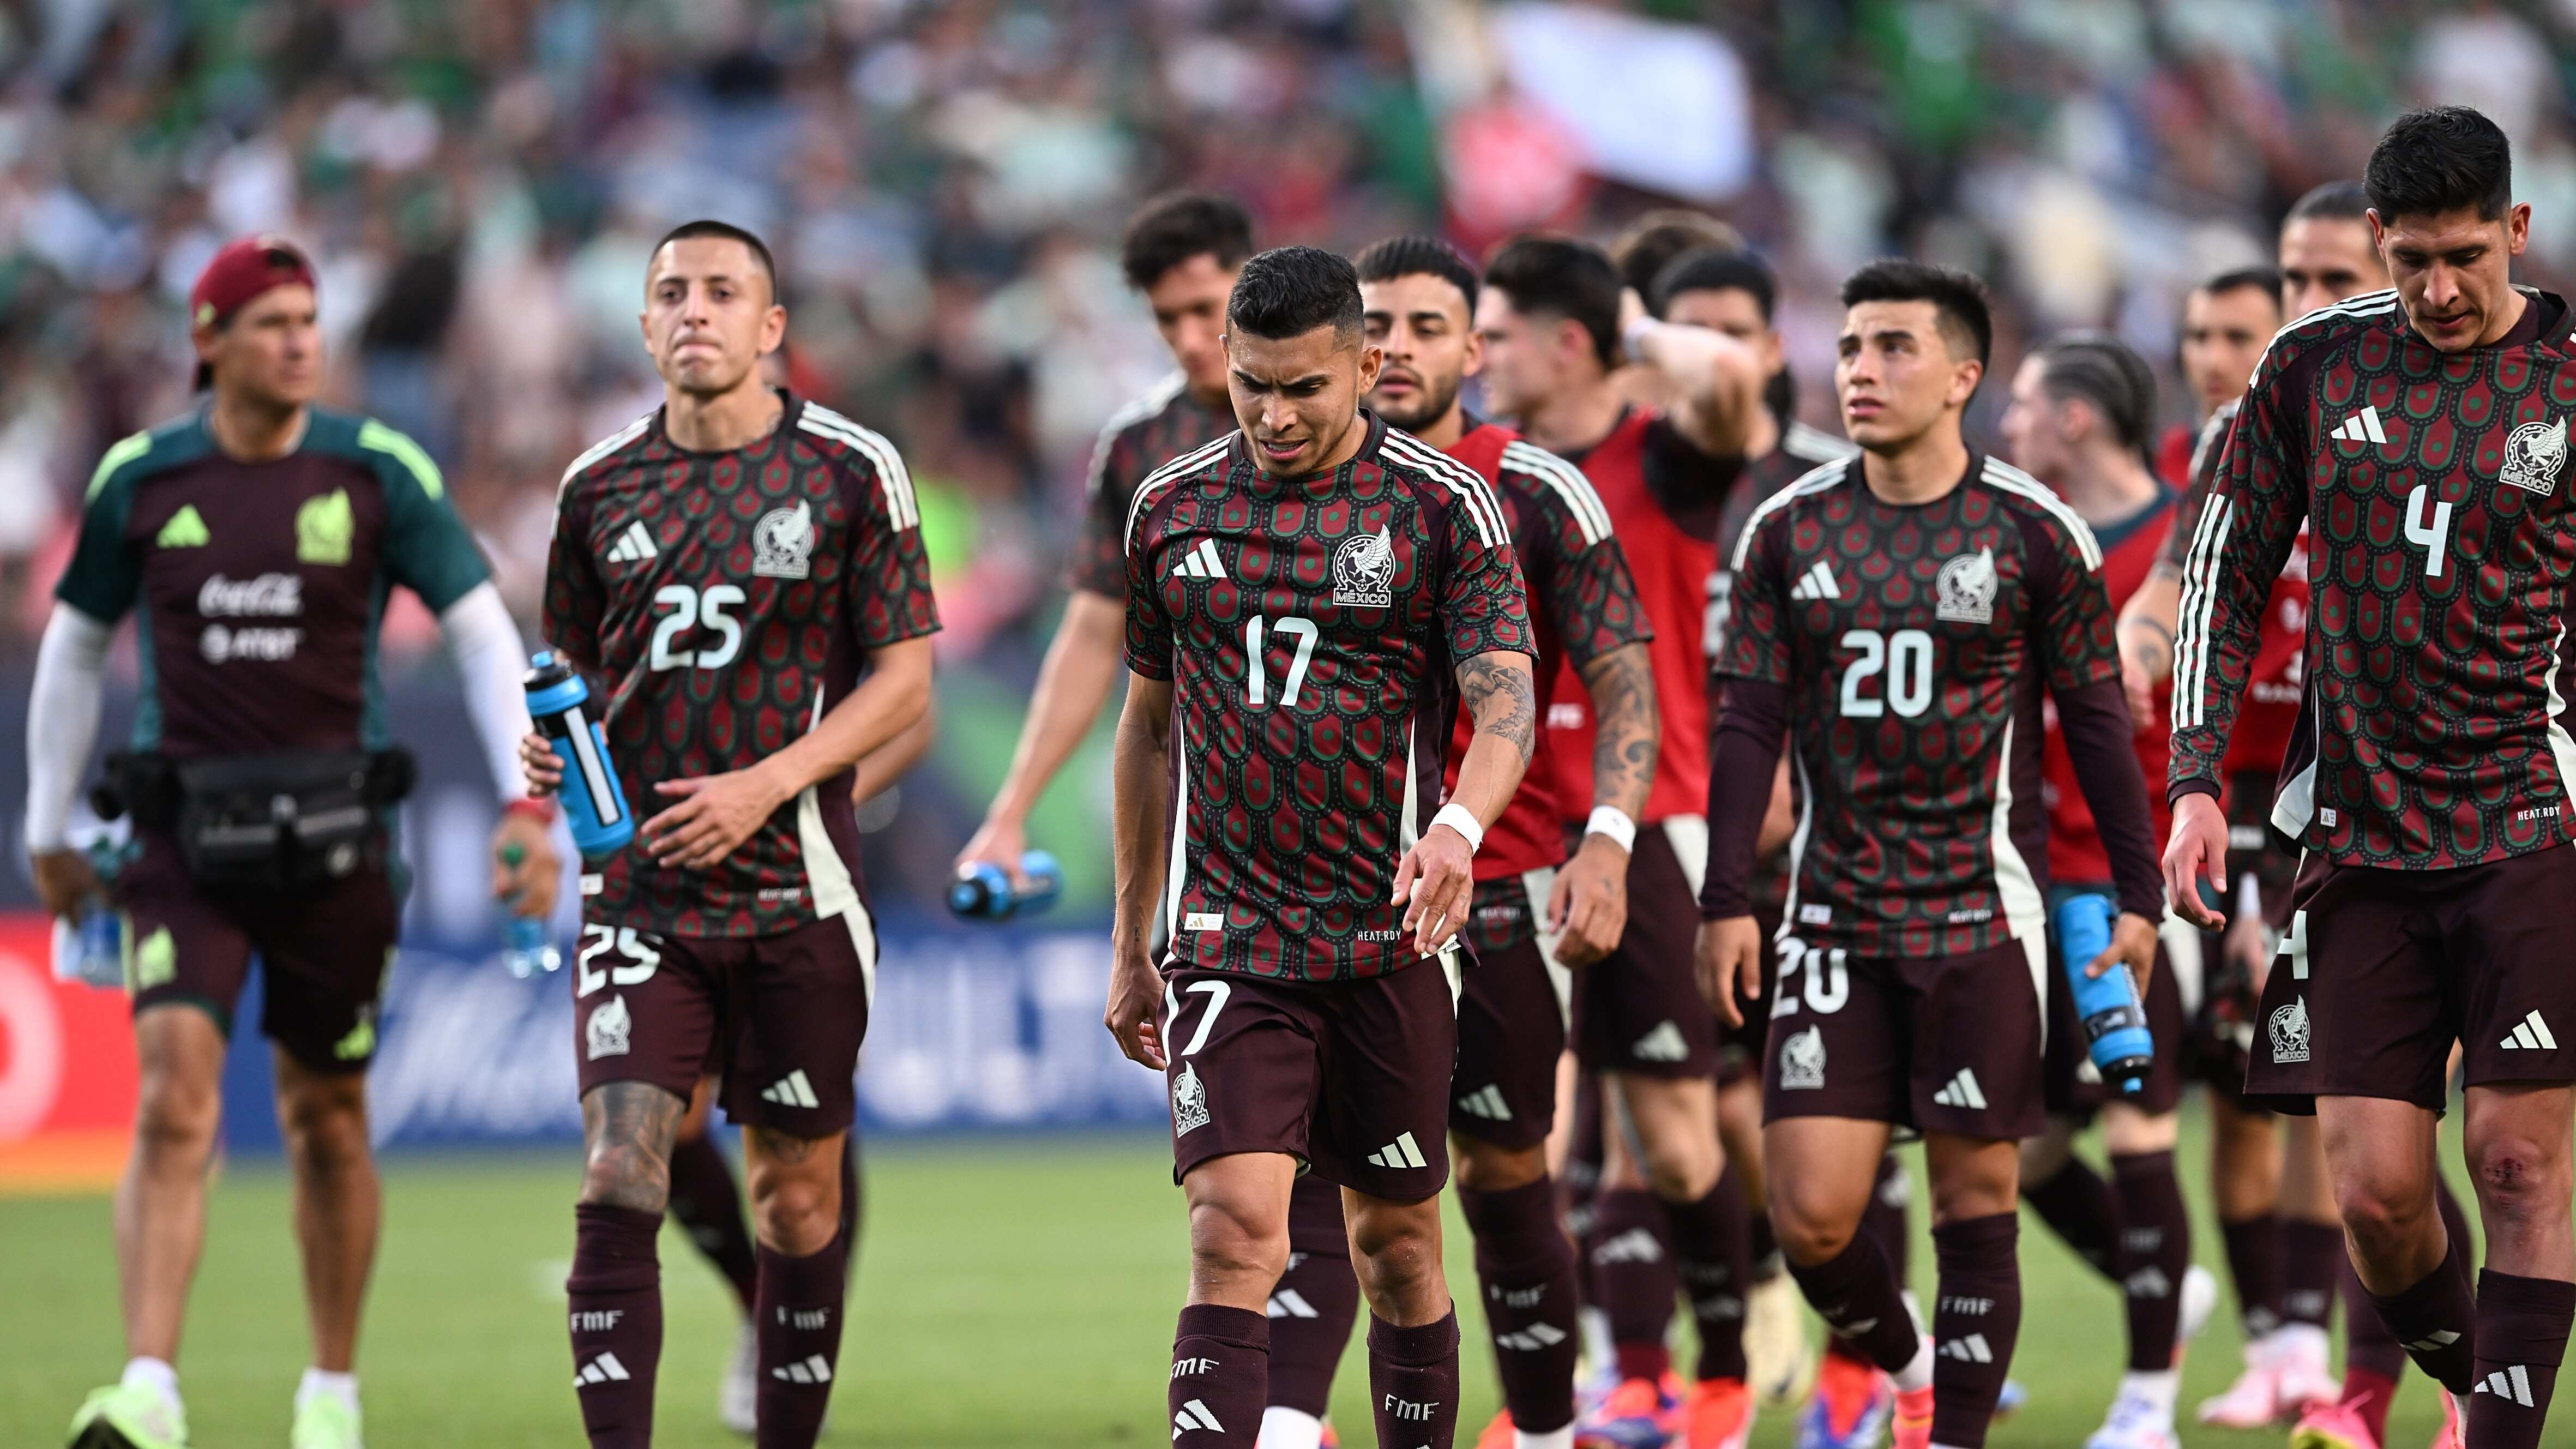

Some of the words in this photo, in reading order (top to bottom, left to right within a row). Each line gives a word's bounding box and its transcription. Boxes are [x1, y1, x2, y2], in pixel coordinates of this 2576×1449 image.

[2502, 470, 2551, 492] MÉXICO
[2404, 484, 2452, 577] 4
[1335, 589, 1388, 604] MÉXICO
[650, 585, 746, 671] 25
[1245, 614, 1319, 706] 17
[1840, 629, 1933, 718] 20
[2517, 806, 2560, 821] HEAT.RDY
[1357, 930, 1401, 941] HEAT.RDY
[578, 923, 664, 999] 25
[1769, 936, 1849, 1020] 20
[1161, 979, 1231, 1067] 17
[2275, 1049, 2308, 1061] MÉXICO
[1177, 1113, 1207, 1135] MÉXICO
[571, 1310, 624, 1333] FMF
[1385, 1393, 1440, 1421] FMF
